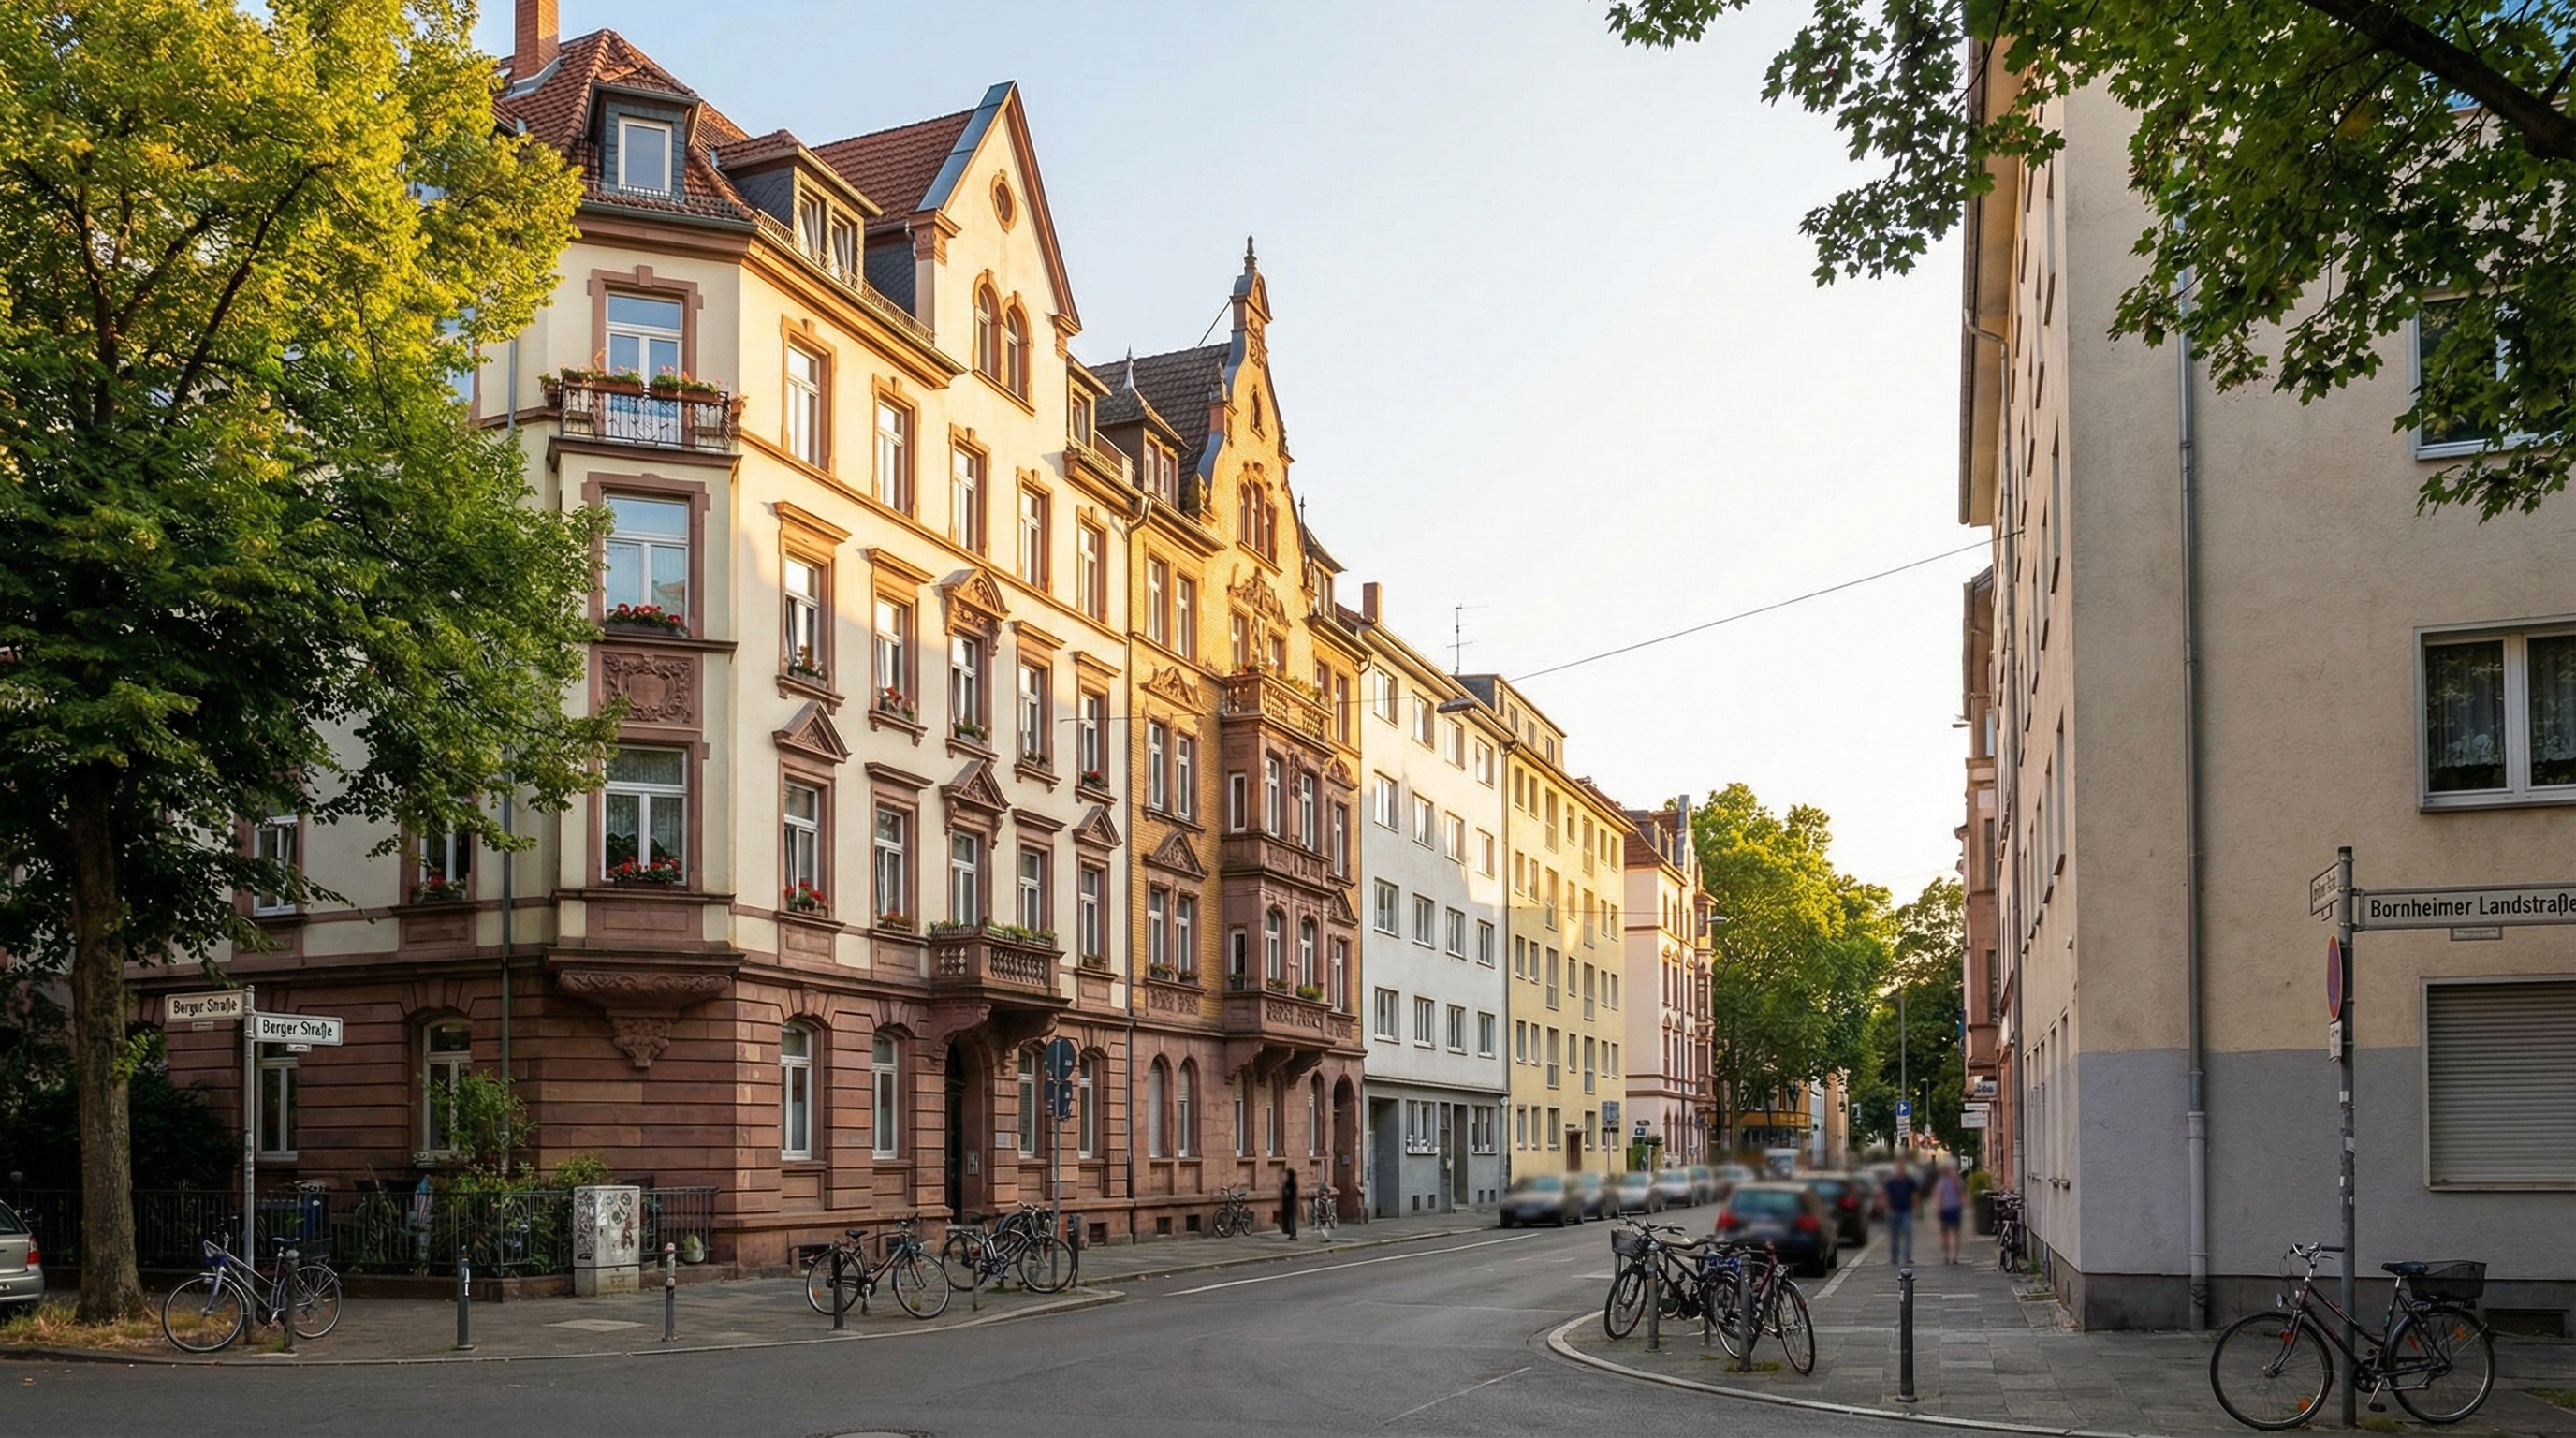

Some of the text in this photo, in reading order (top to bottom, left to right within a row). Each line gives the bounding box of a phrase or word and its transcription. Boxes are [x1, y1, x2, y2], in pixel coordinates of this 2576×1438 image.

[2370, 892, 2576, 918] Bornheimer Landstraße
[262, 1019, 298, 1038] Berger
